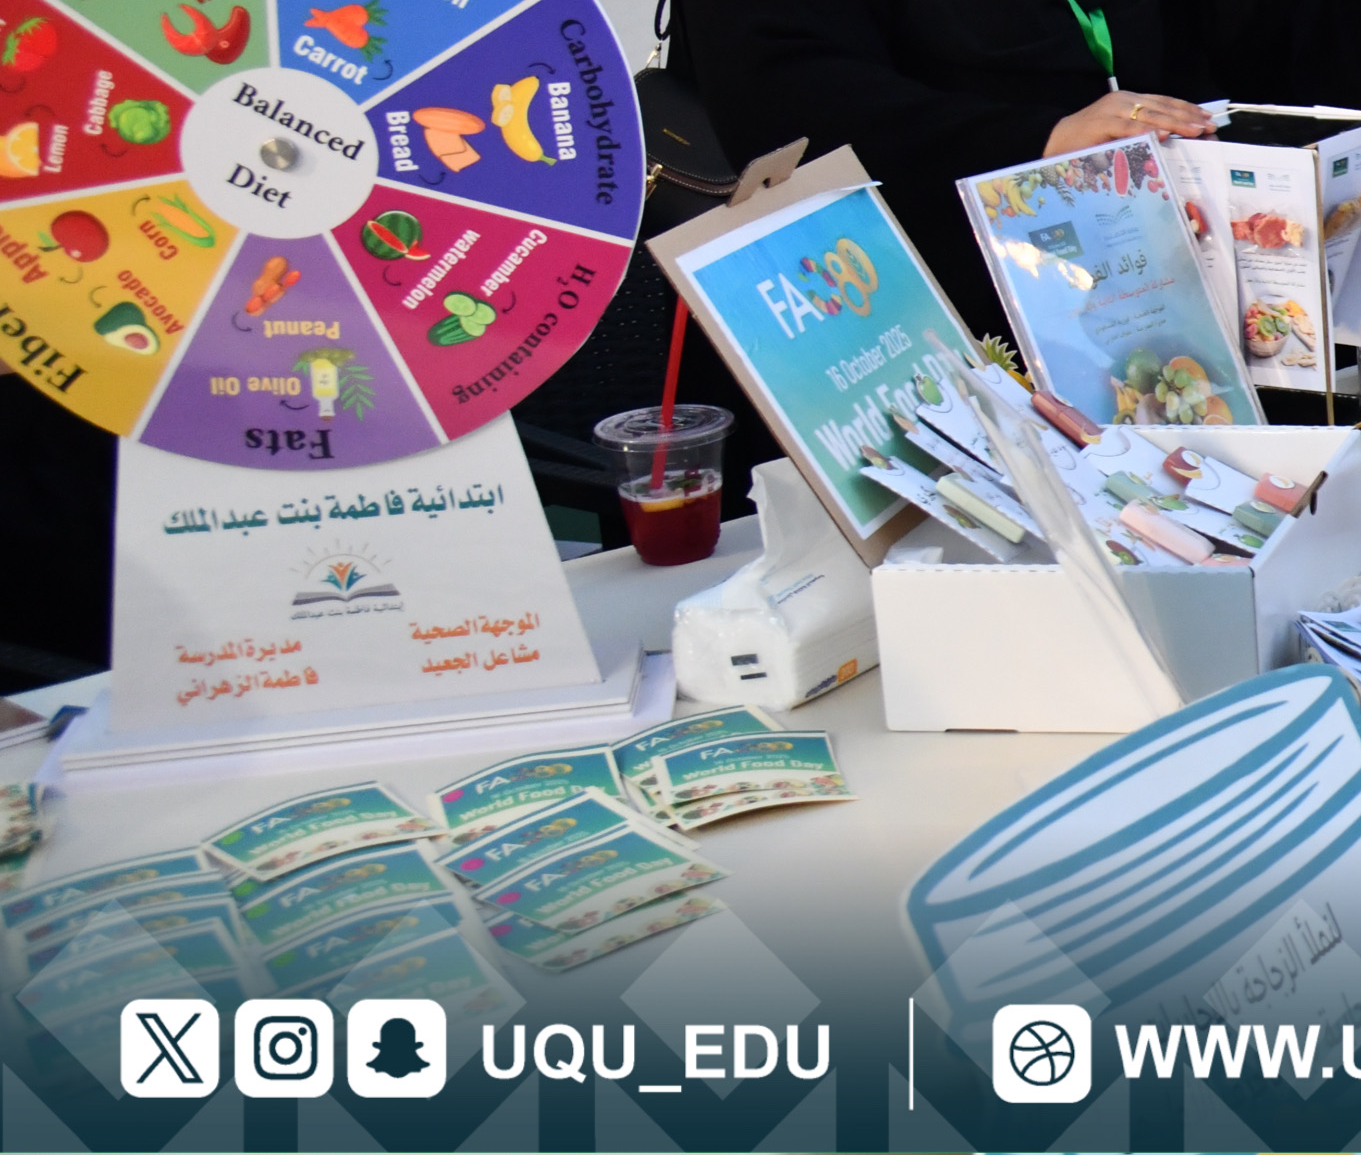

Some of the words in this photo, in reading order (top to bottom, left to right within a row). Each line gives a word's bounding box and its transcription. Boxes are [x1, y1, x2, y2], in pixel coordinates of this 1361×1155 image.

[292, 34, 369, 87] Carrot
[83, 69, 116, 136] Cabbage
[232, 81, 366, 163] Balanced
[547, 81, 578, 161] Banana
[559, 18, 622, 206] Carbohydrate
[44, 124, 69, 174] Lemon
[385, 110, 420, 173] Bread
[225, 163, 293, 210] Diet
[0, 224, 50, 284] Appl
[138, 219, 180, 262] Corn
[401, 229, 482, 310] watermelon
[480, 228, 548, 298] Cucamber
[1117, 249, 1148, 276] فوائد
[117, 269, 187, 336] Avocado
[0, 302, 89, 394] Fiber
[264, 319, 341, 341] Peanut
[451, 312, 559, 405] containing
[825, 365, 849, 393] 16
[839, 345, 887, 385] October
[878, 324, 913, 359] 2025
[210, 375, 242, 396] Oil
[248, 375, 302, 396] Olive
[245, 426, 335, 461] Fats
[814, 395, 894, 472] World
[276, 497, 322, 530] بنت
[325, 489, 405, 522] فاطمة
[407, 484, 505, 520] ابتدائية
[409, 619, 477, 645] الصحية
[477, 612, 541, 638] الموجهة
[173, 641, 244, 667] المدرسة
[244, 638, 303, 663] مديرة
[422, 652, 479, 677] الجعيد
[483, 644, 540, 671] مشاعل
[176, 674, 260, 706] الزهراني
[260, 666, 320, 691] فاطمة
[682, 762, 736, 782] World
[741, 759, 786, 770] Food
[791, 759, 825, 771] Day
[459, 793, 514, 821] World
[518, 786, 566, 805] Food
[535, 885, 594, 915] World
[594, 869, 638, 891] Food
[637, 857, 675, 873] Day
